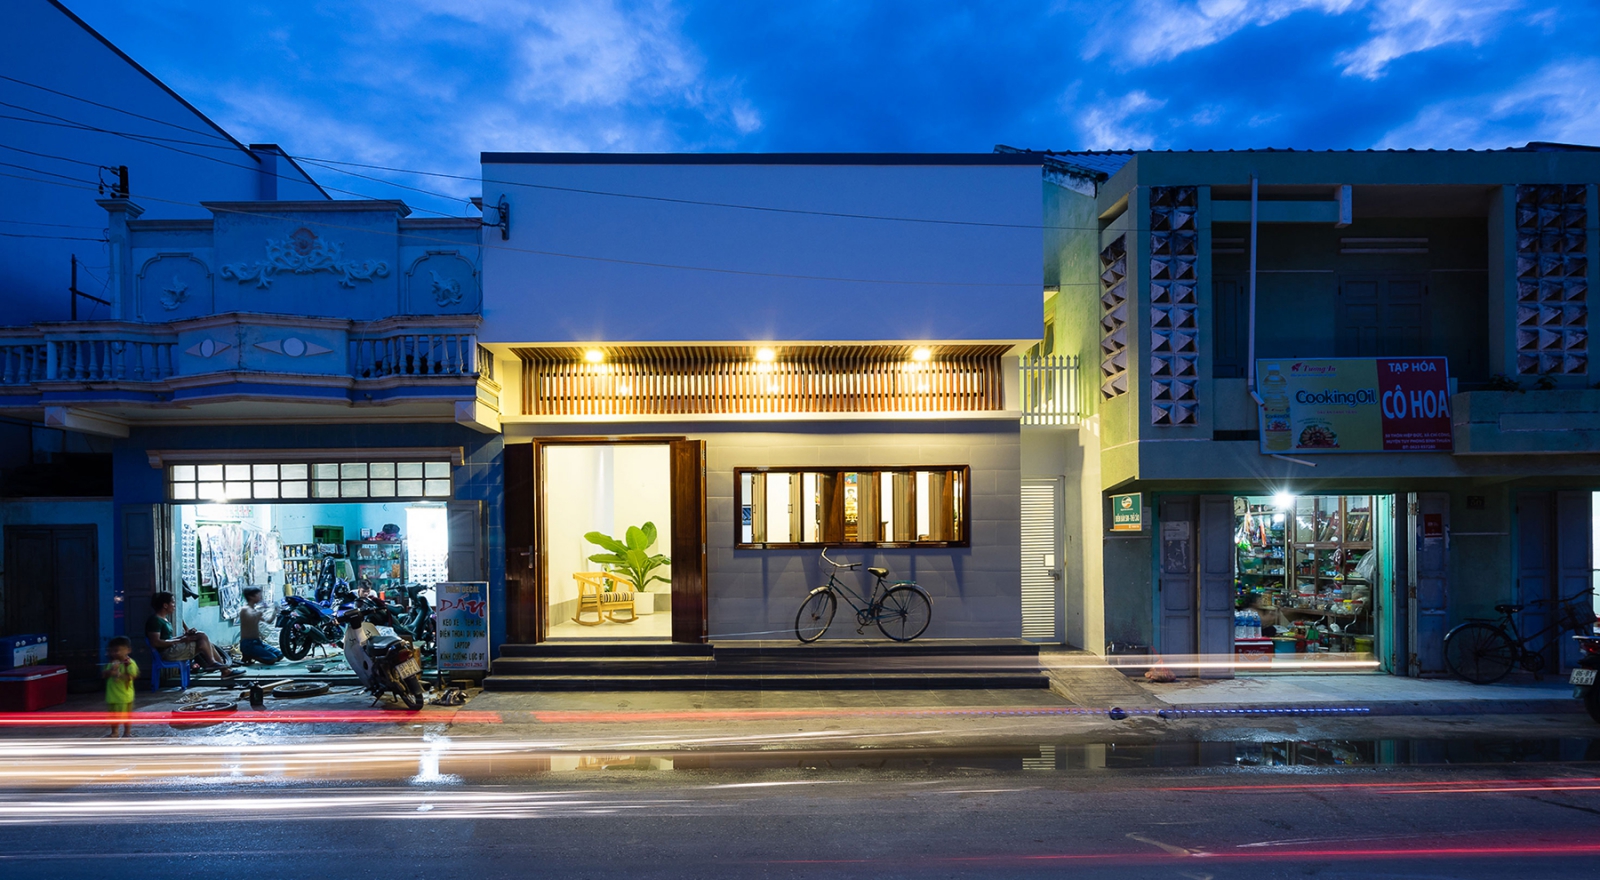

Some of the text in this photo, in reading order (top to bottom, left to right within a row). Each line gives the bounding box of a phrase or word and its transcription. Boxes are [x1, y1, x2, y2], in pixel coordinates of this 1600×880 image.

[1388, 360, 1436, 374] TẠP HÓA
[1296, 390, 1376, 406] CookingOil
[1382, 384, 1450, 419] CÔ HOA
